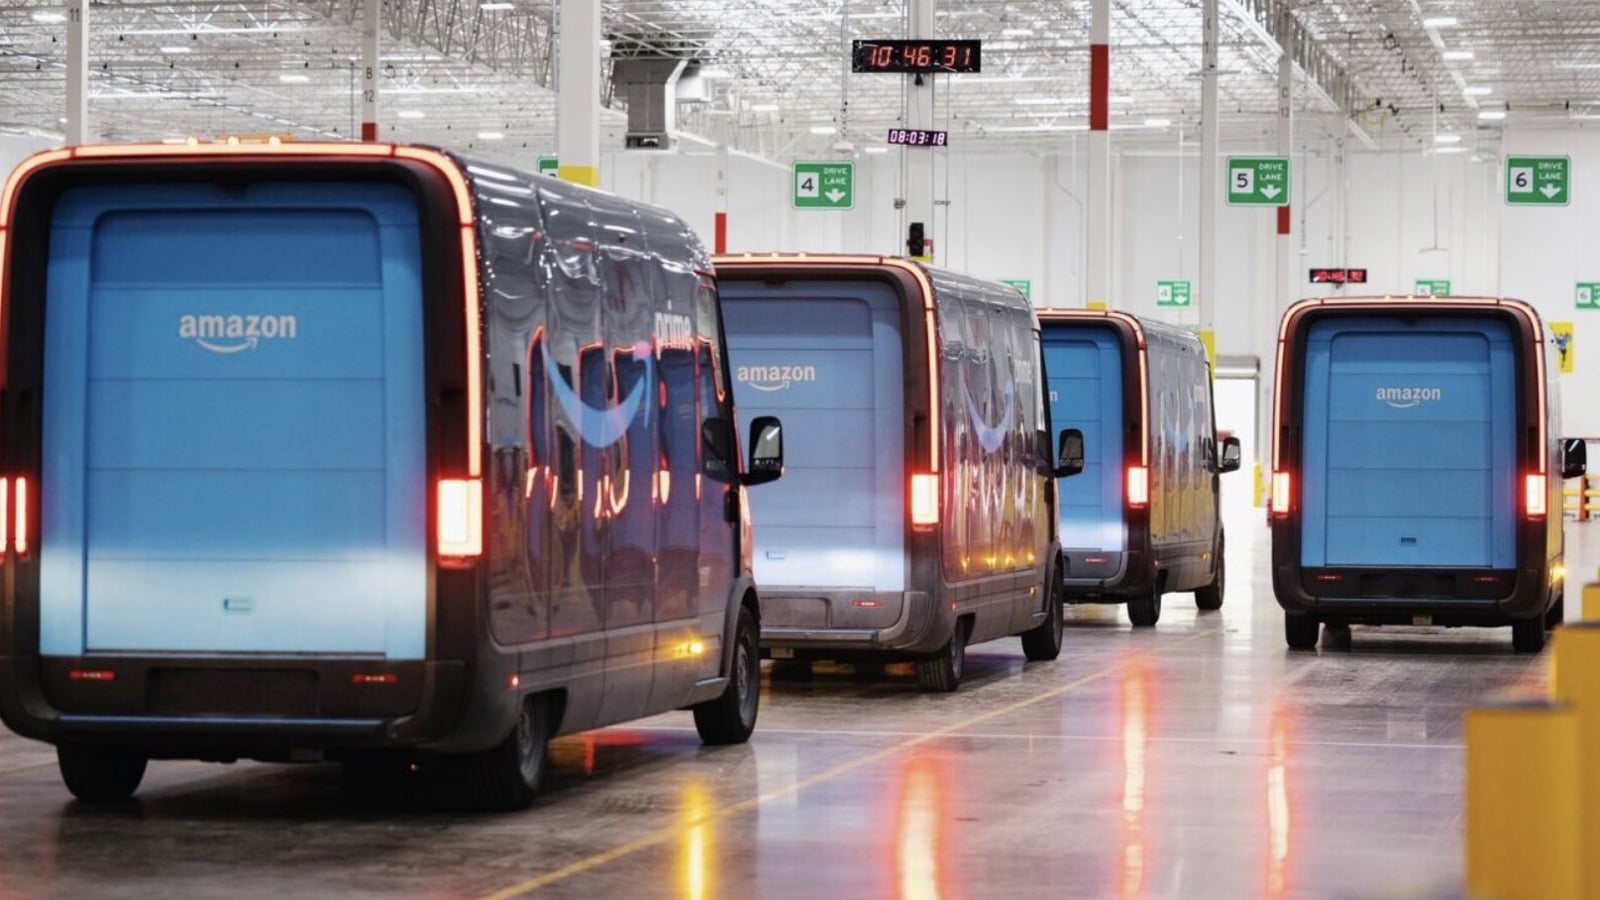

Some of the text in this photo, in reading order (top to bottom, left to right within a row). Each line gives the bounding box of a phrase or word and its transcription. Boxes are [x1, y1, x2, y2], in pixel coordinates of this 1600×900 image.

[889, 130, 946, 145] 08:03:18
[823, 167, 848, 175] DRIVE
[1258, 162, 1283, 170] DRIVE
[1537, 162, 1563, 170] DRIVE
[823, 177, 847, 185] LANE
[1237, 172, 1249, 188] 5
[1258, 173, 1282, 181] LANE
[1515, 171, 1528, 188] 6
[1538, 172, 1562, 180] LANE
[801, 176, 815, 192] 4
[179, 314, 297, 338] amazon
[737, 365, 816, 381] amazon
[1376, 387, 1441, 401] amazon
